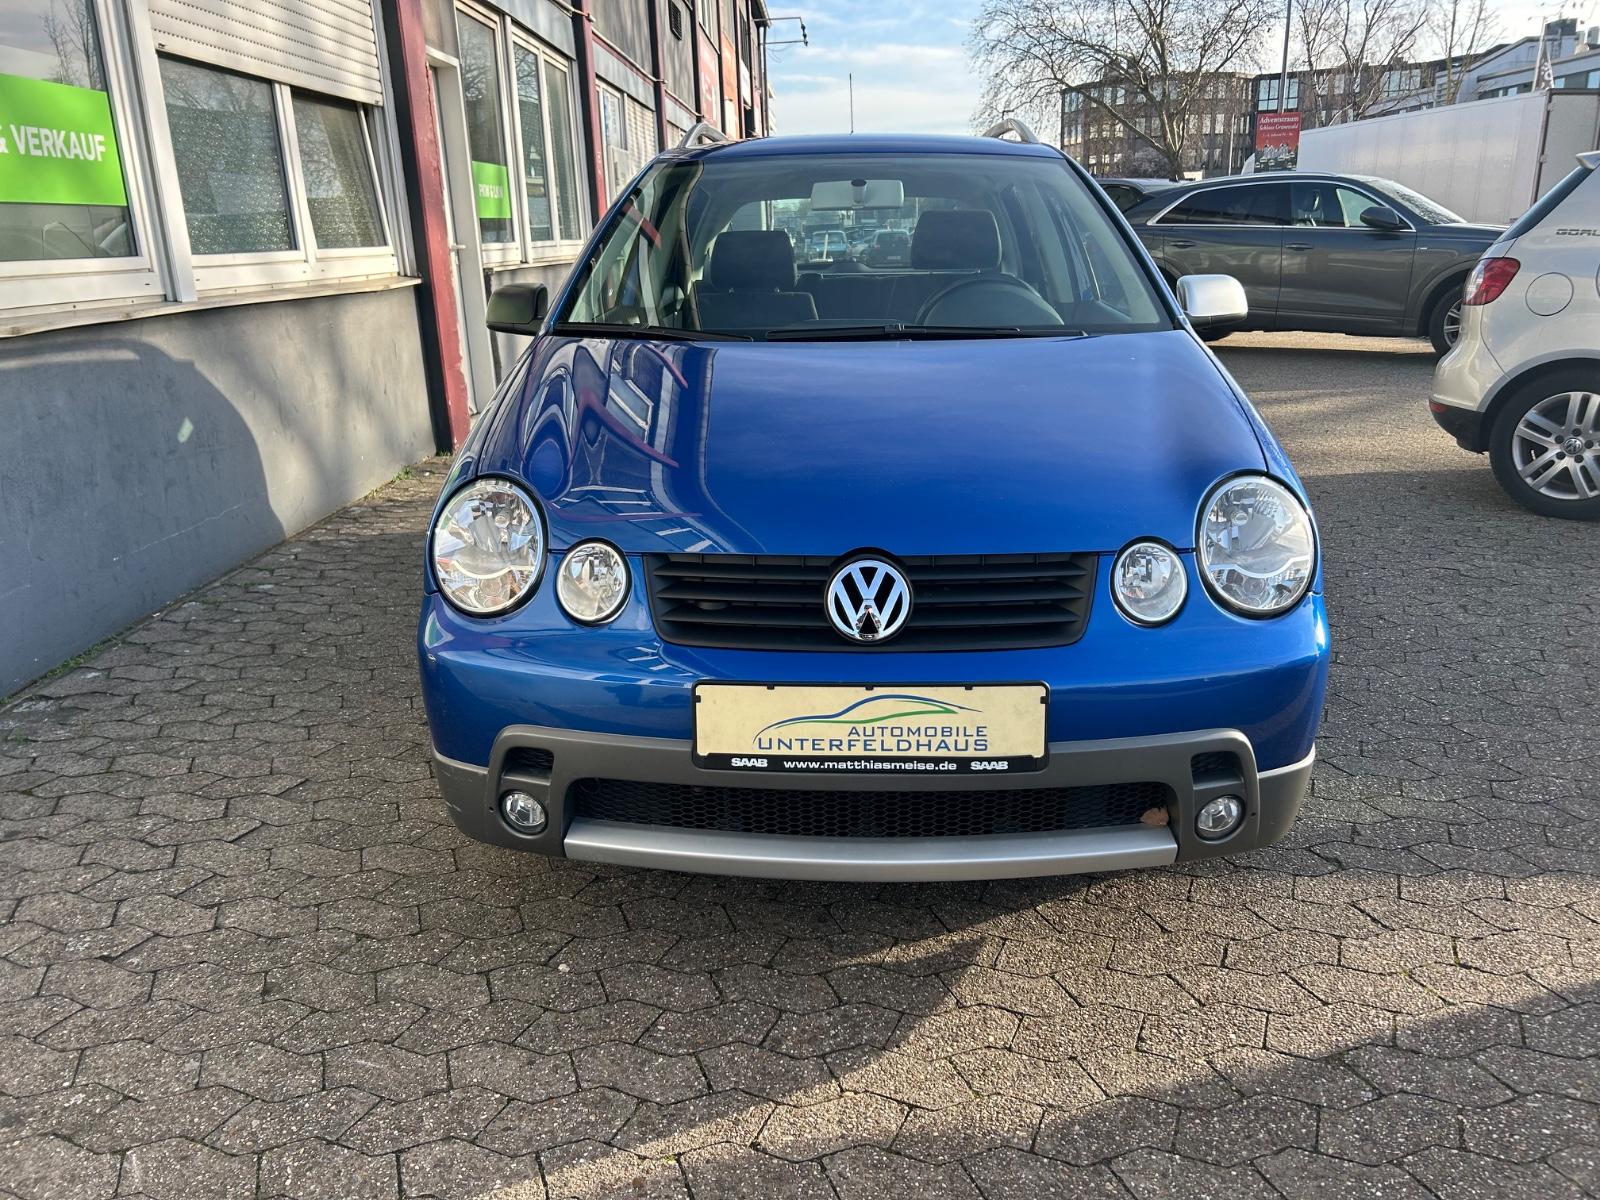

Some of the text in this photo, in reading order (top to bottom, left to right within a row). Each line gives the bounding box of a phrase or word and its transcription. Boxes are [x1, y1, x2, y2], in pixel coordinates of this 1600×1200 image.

[9, 124, 106, 161] VERKAUF
[848, 726, 988, 738] AUTOMOBILE
[758, 737, 989, 752] UNTERFELDHAUS
[731, 757, 1009, 772] SAAB www.matthiasmeise.de SAAB
